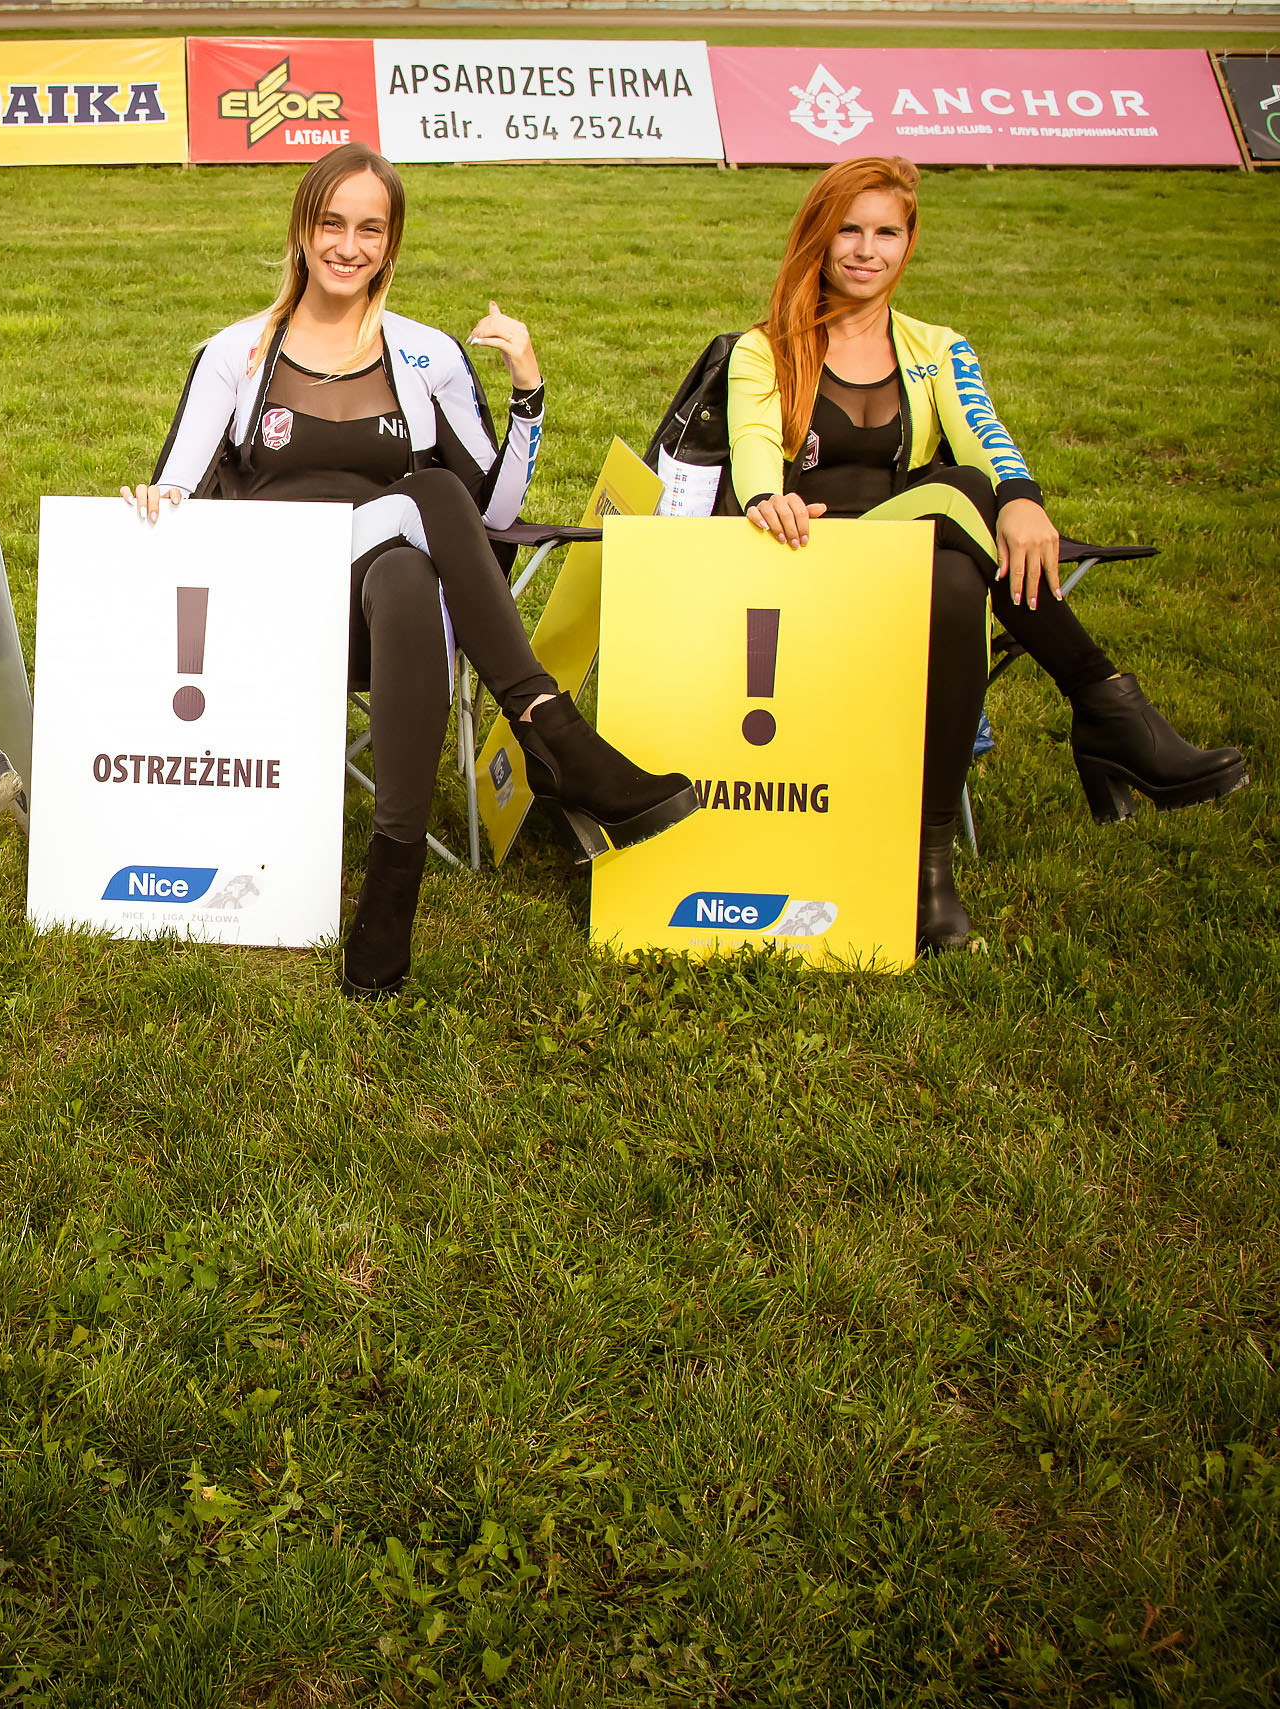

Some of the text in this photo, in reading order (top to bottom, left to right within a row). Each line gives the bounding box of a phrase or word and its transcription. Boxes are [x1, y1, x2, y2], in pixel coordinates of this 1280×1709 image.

[388, 64, 693, 98] APSARDZES FIRMA
[891, 88, 1150, 117] ANCHOR
[285, 129, 351, 145] LATGALE
[420, 110, 664, 140] tālr. 654 25244
[956, 125, 993, 135] KLUBS
[1010, 127, 1039, 137] КЛУБ
[906, 363, 939, 384] Nce
[92, 750, 281, 789] OSTRZEŻENIE
[128, 872, 190, 898] Nice
[122, 911, 145, 920] NICE
[162, 913, 185, 921] LIGA
[696, 898, 760, 925] Nice
